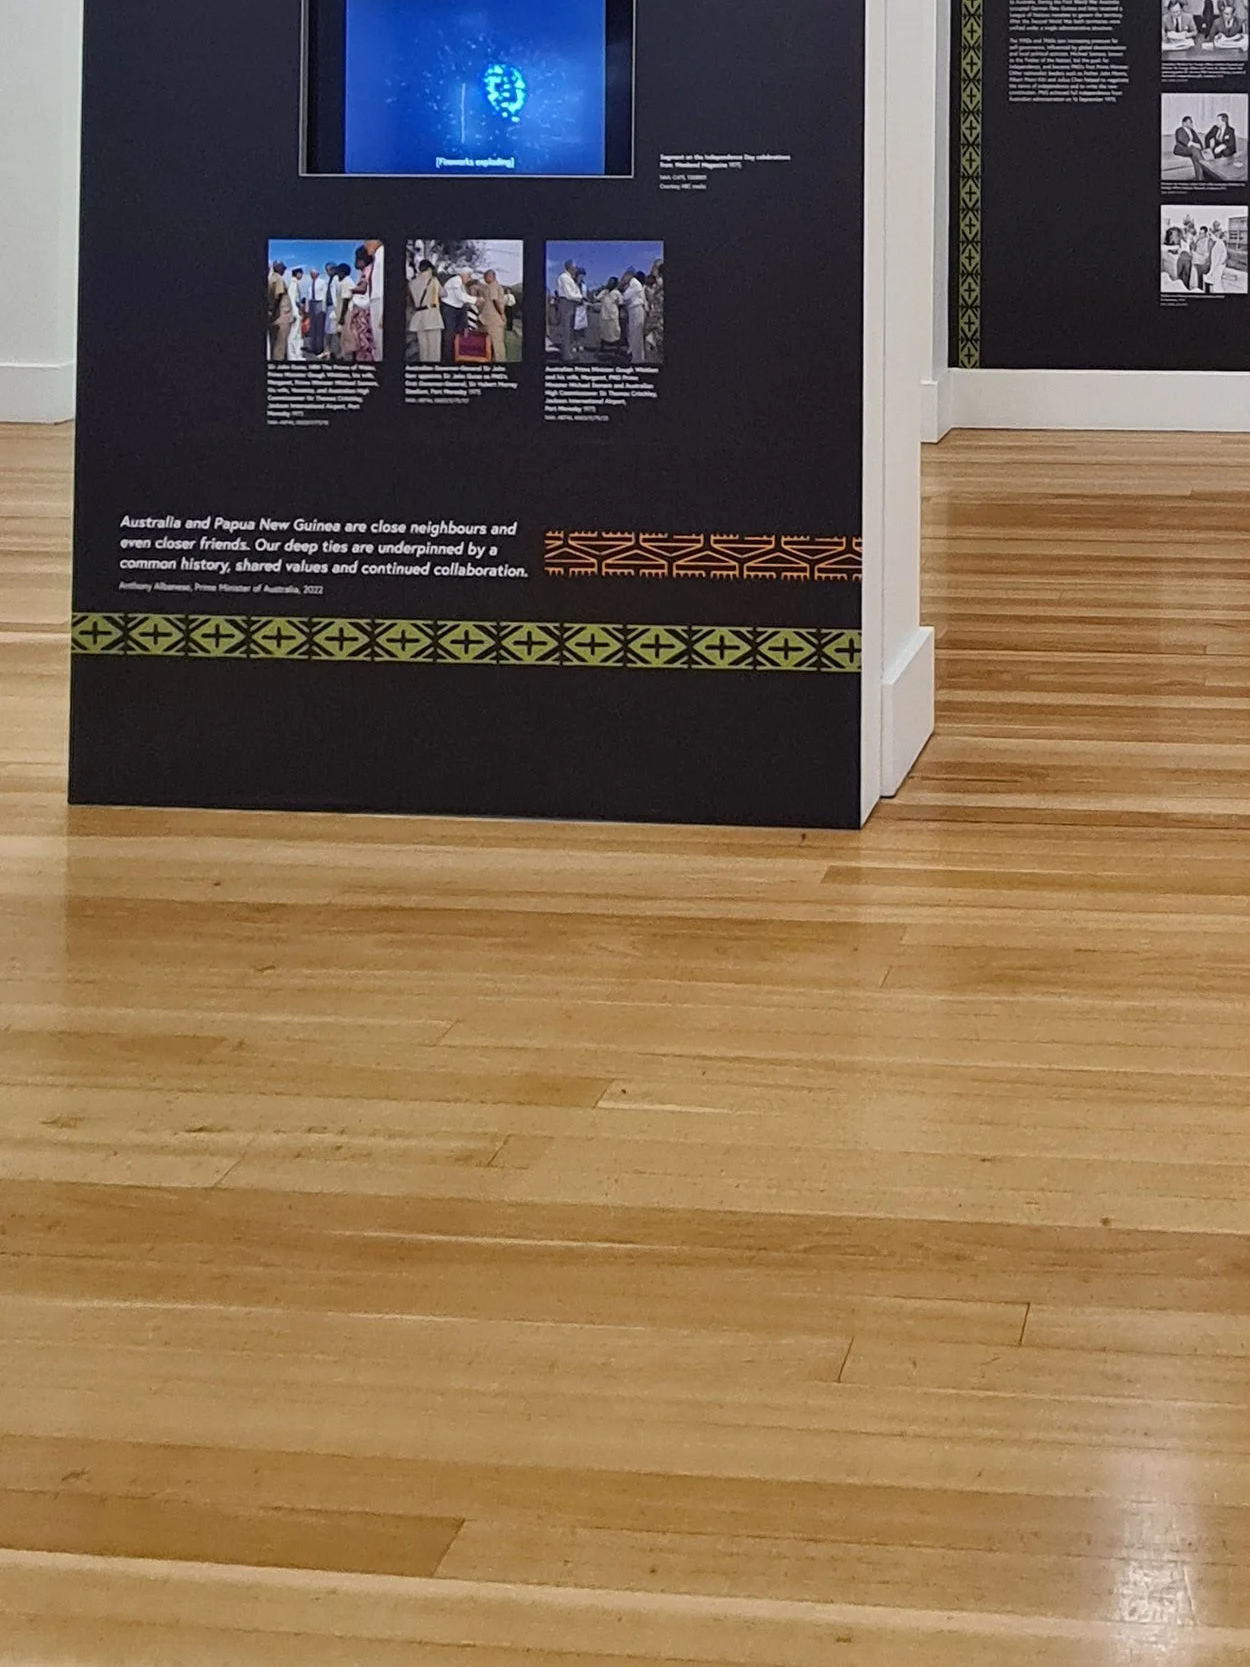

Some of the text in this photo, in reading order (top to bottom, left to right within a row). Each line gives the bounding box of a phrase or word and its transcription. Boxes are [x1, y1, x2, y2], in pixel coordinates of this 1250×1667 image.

[119, 514, 518, 537] Australia and Papua New Guinea are close neighbours and
[119, 536, 498, 557] even closer friends. Our deep ties are underpinned by a
[119, 557, 528, 577] common history, shared values and continued collaboration.
